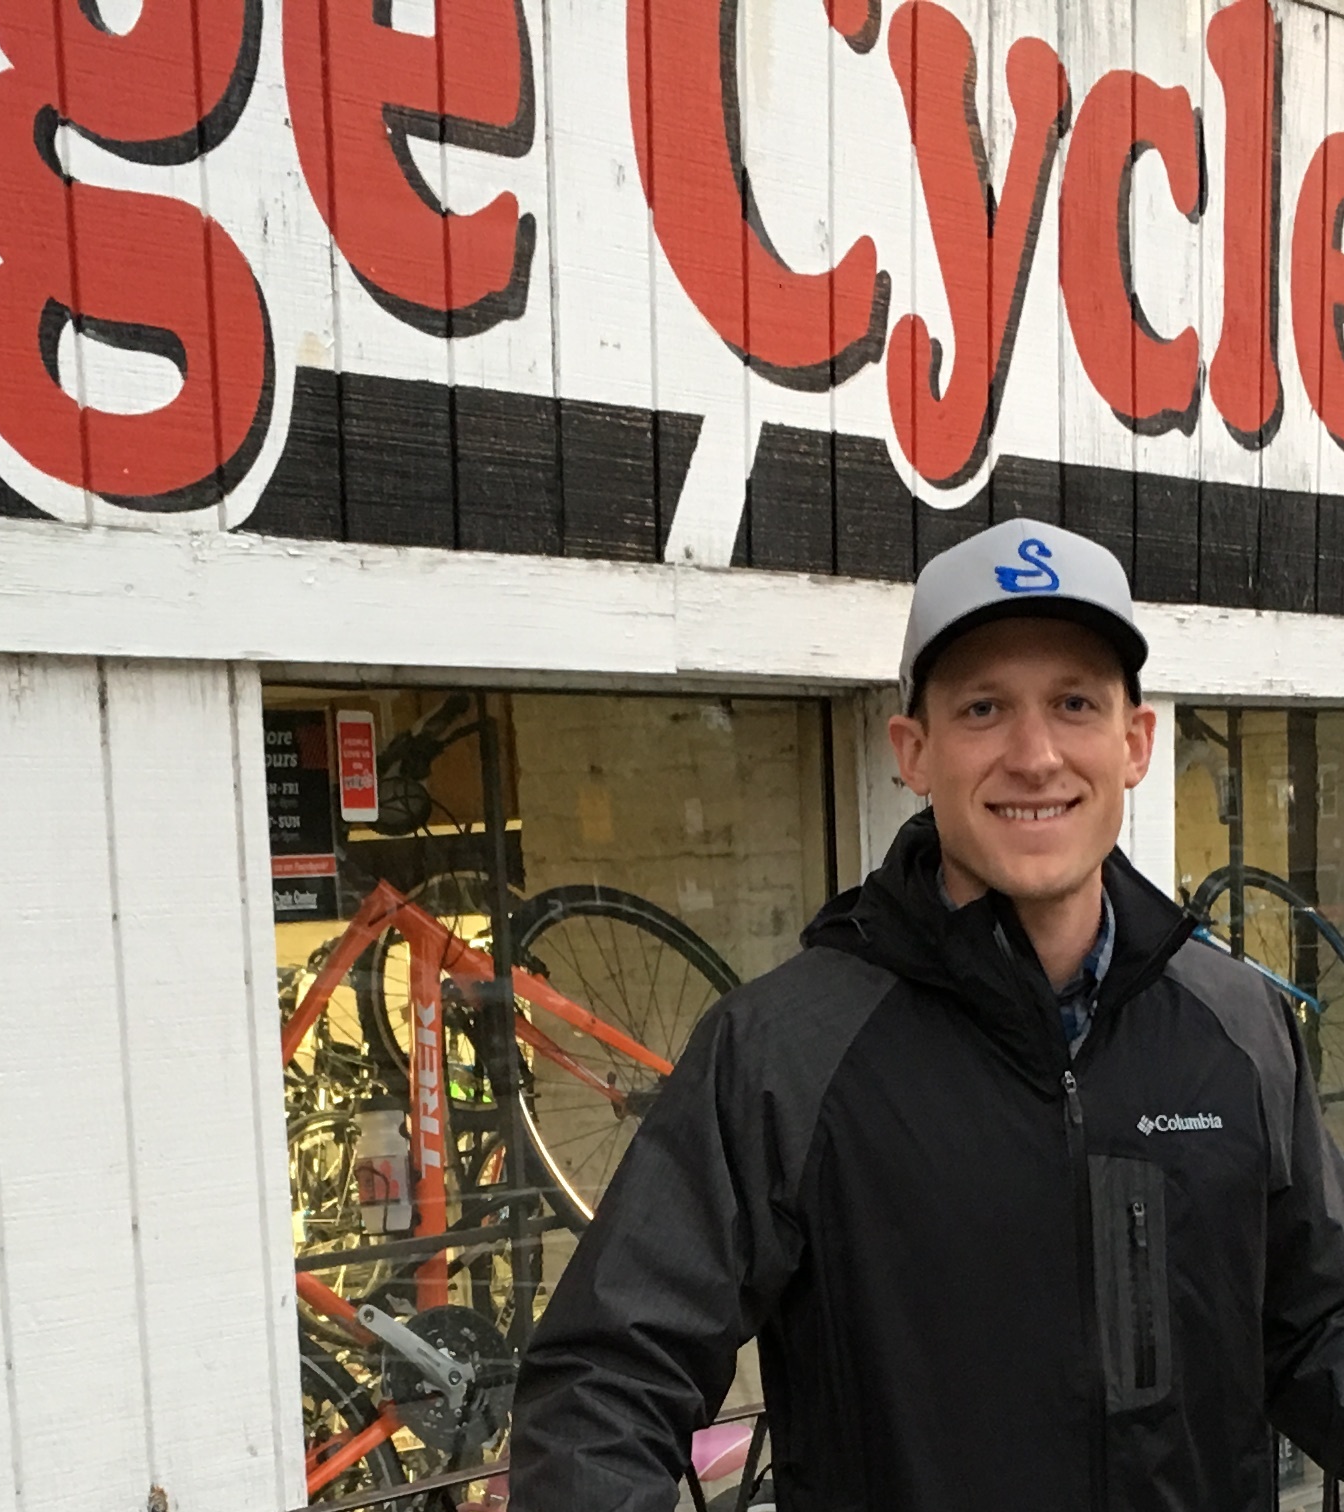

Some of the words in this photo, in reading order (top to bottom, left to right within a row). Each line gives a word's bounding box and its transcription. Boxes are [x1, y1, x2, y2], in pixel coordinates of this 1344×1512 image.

[263, 729, 293, 746] ore
[417, 1001, 441, 1179] TREK
[1155, 1113, 1223, 1132] Columbia
